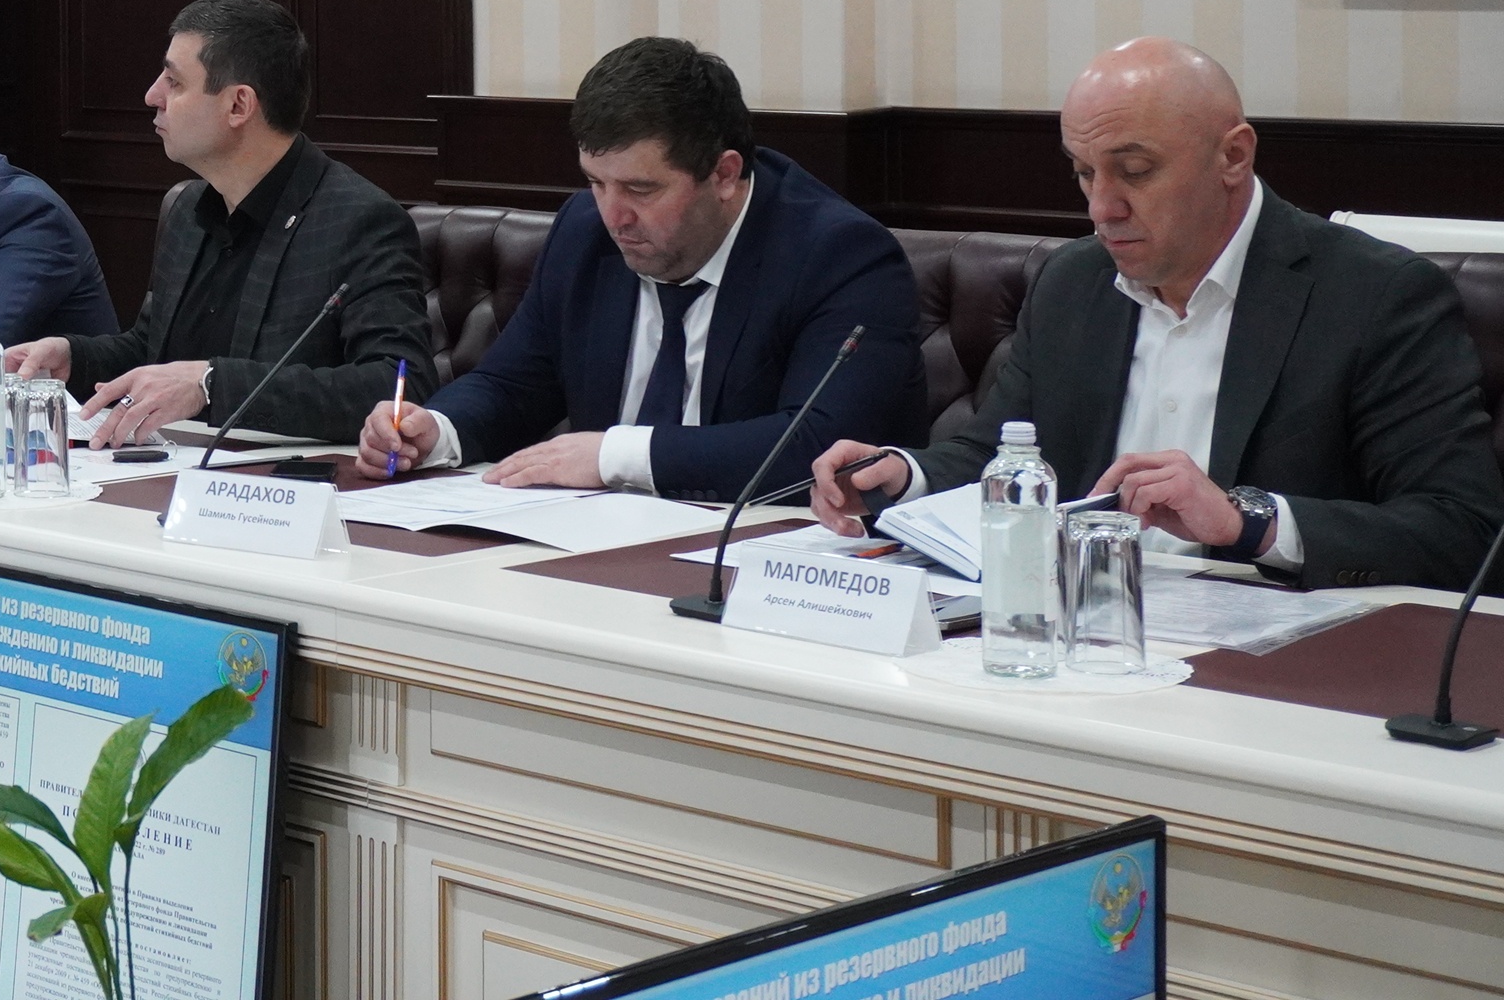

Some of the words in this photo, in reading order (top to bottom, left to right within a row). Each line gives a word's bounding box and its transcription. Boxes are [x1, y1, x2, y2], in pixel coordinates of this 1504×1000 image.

[205, 480, 296, 505] АРАДАХОВ
[198, 507, 236, 521] Шамиль
[237, 511, 291, 528] Гусейнович
[763, 559, 891, 596] МАГОМЕДОВ
[0, 595, 19, 617] из
[19, 599, 100, 636] резервного
[100, 613, 152, 648] фонда
[763, 593, 795, 607] Арсен
[796, 598, 873, 620] Алишейхович
[59, 638, 70, 658] и
[71, 641, 164, 681] ликвидации
[49, 661, 121, 700] бедствий
[39, 778, 83, 799] ПРАВИТЕЛ
[172, 813, 221, 837] ДАГЕСТАН
[793, 967, 820, 1000] из
[824, 931, 939, 995] резервного
[942, 911, 1007, 955] фонда
[905, 948, 1026, 1000] ликвидации
